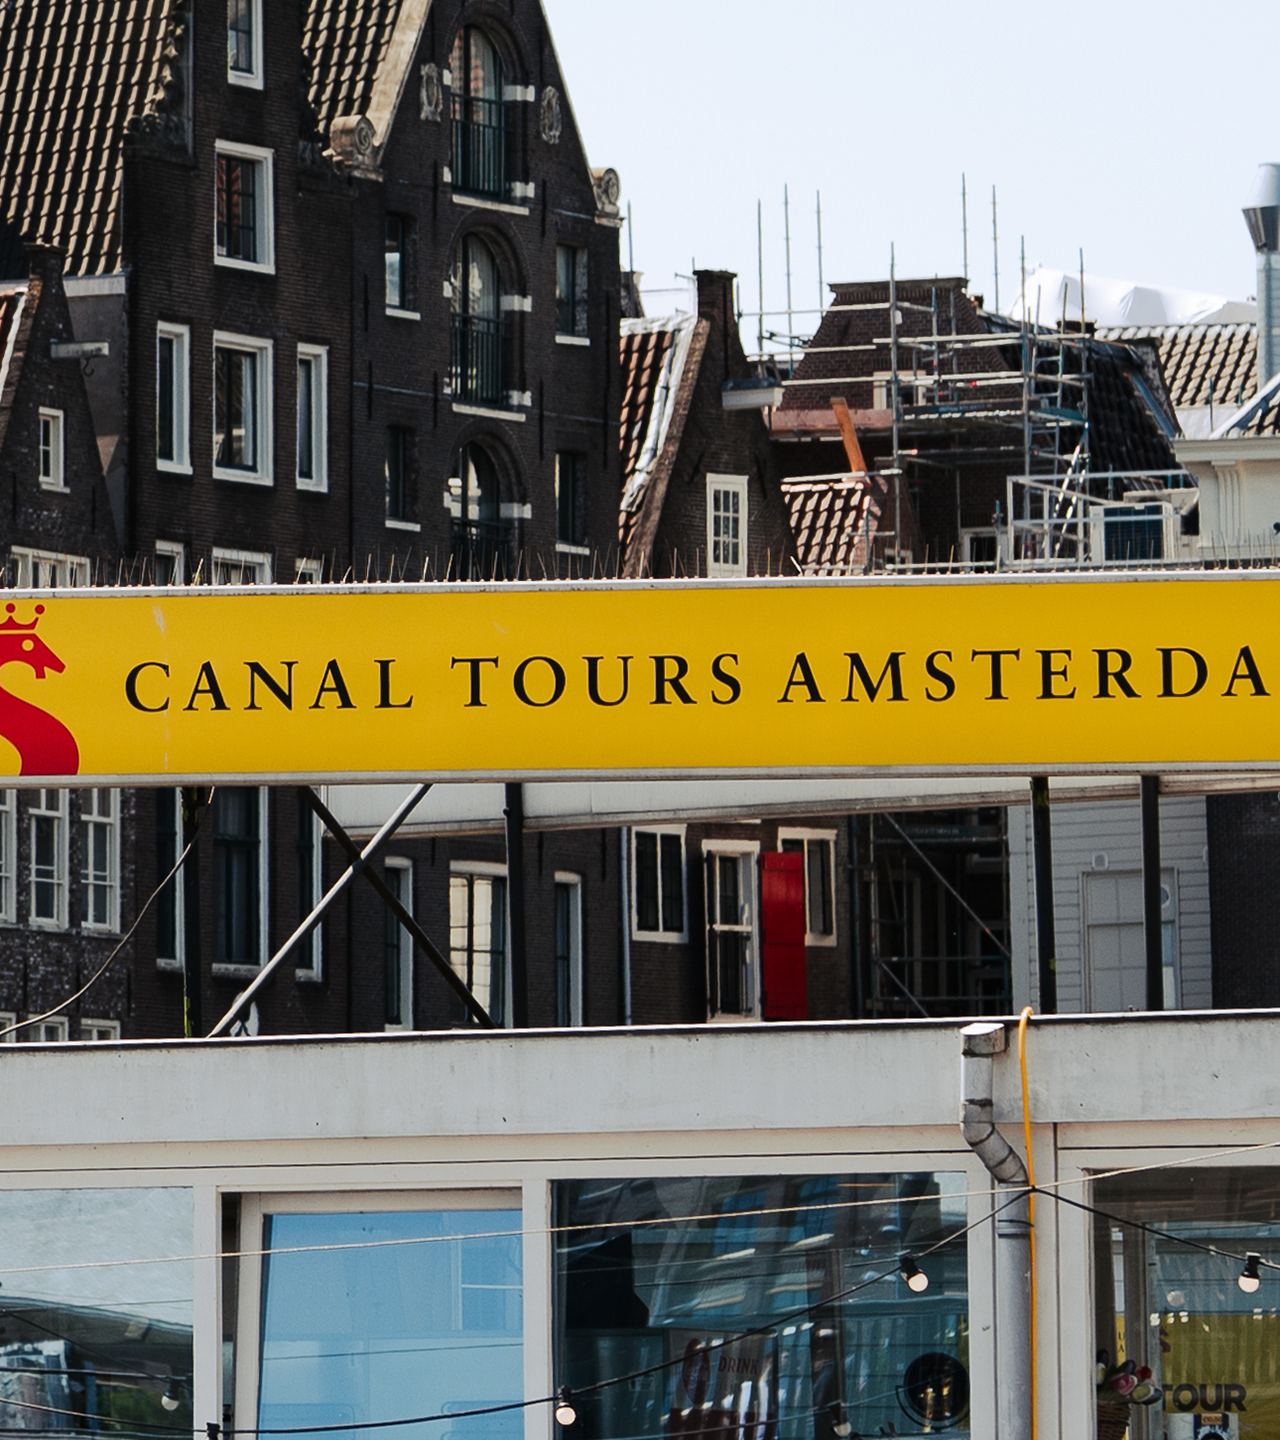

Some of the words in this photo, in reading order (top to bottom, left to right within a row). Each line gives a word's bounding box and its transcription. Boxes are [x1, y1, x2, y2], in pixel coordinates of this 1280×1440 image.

[125, 658, 414, 713] CANAL
[450, 653, 741, 708] TOURS
[776, 645, 1271, 703] AMSTERDA
